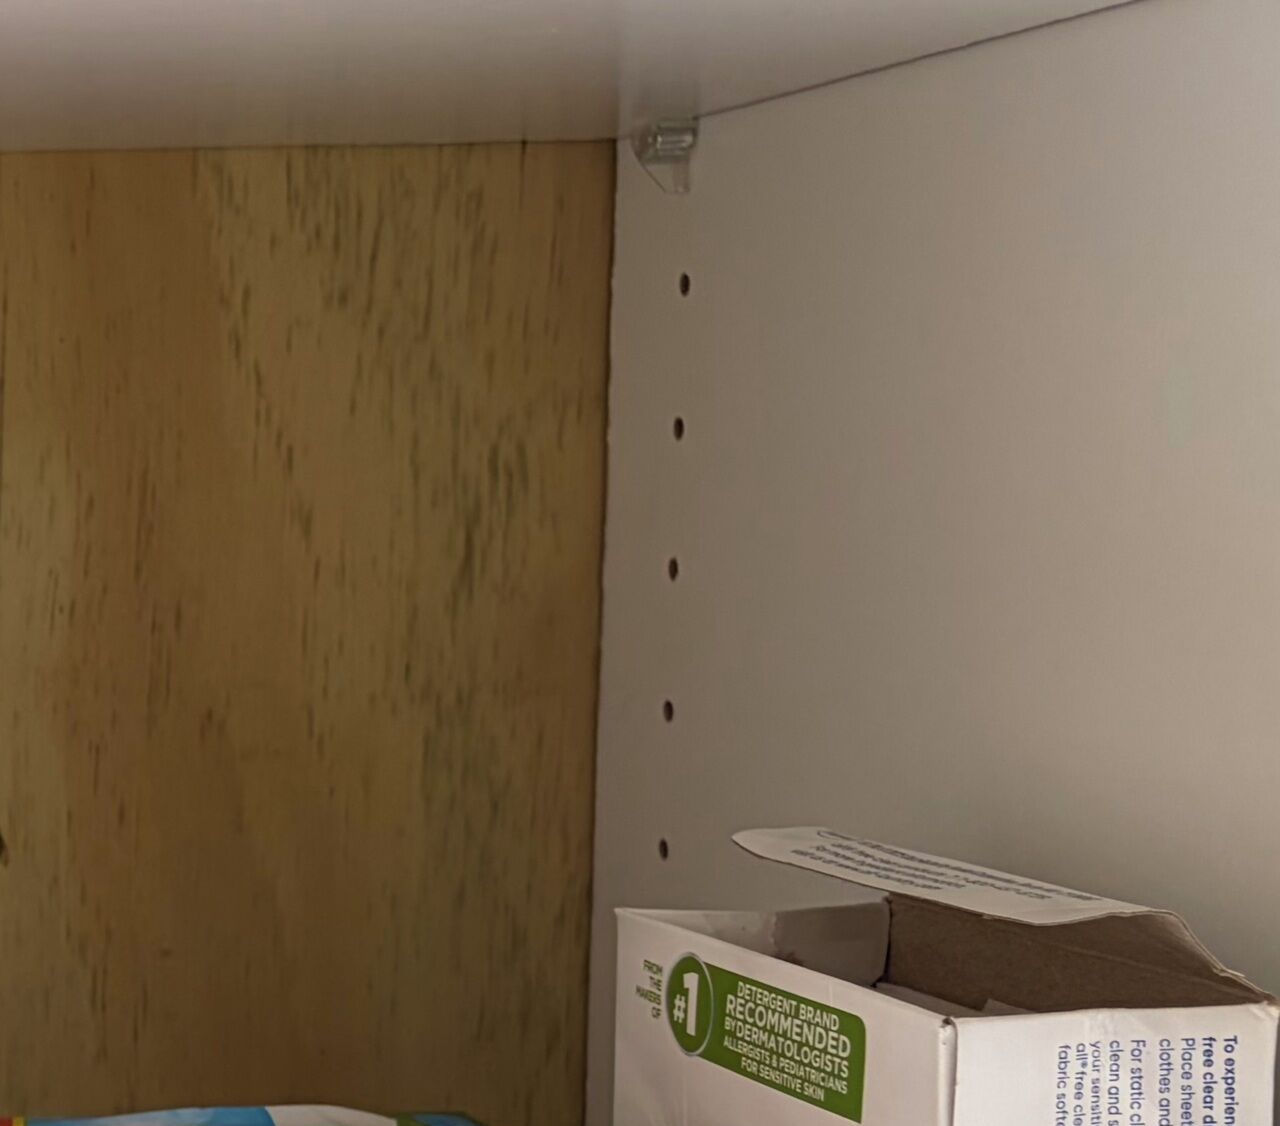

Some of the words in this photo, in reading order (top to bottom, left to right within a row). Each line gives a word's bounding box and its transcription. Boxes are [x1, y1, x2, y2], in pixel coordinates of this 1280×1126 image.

[673, 971, 700, 1037] #1
[725, 994, 852, 1058] RECOMMENDED
[737, 981, 798, 1013] DETERGENT
[799, 1003, 840, 1032] BRAND
[723, 1036, 771, 1066] ALLERGISTS
[779, 1057, 849, 1095] PEDIATRICIANS
[724, 1016, 736, 1031] BY
[735, 1021, 850, 1078] DERMATOLOGISTS
[1181, 1038, 1195, 1080] Place
[1202, 1036, 1216, 1067] free
[1224, 1036, 1237, 1053] To
[741, 1057, 759, 1075] FOR
[759, 1065, 803, 1093] SENSITIVE
[803, 1083, 826, 1102] SKIN
[1203, 1072, 1216, 1110] clear
